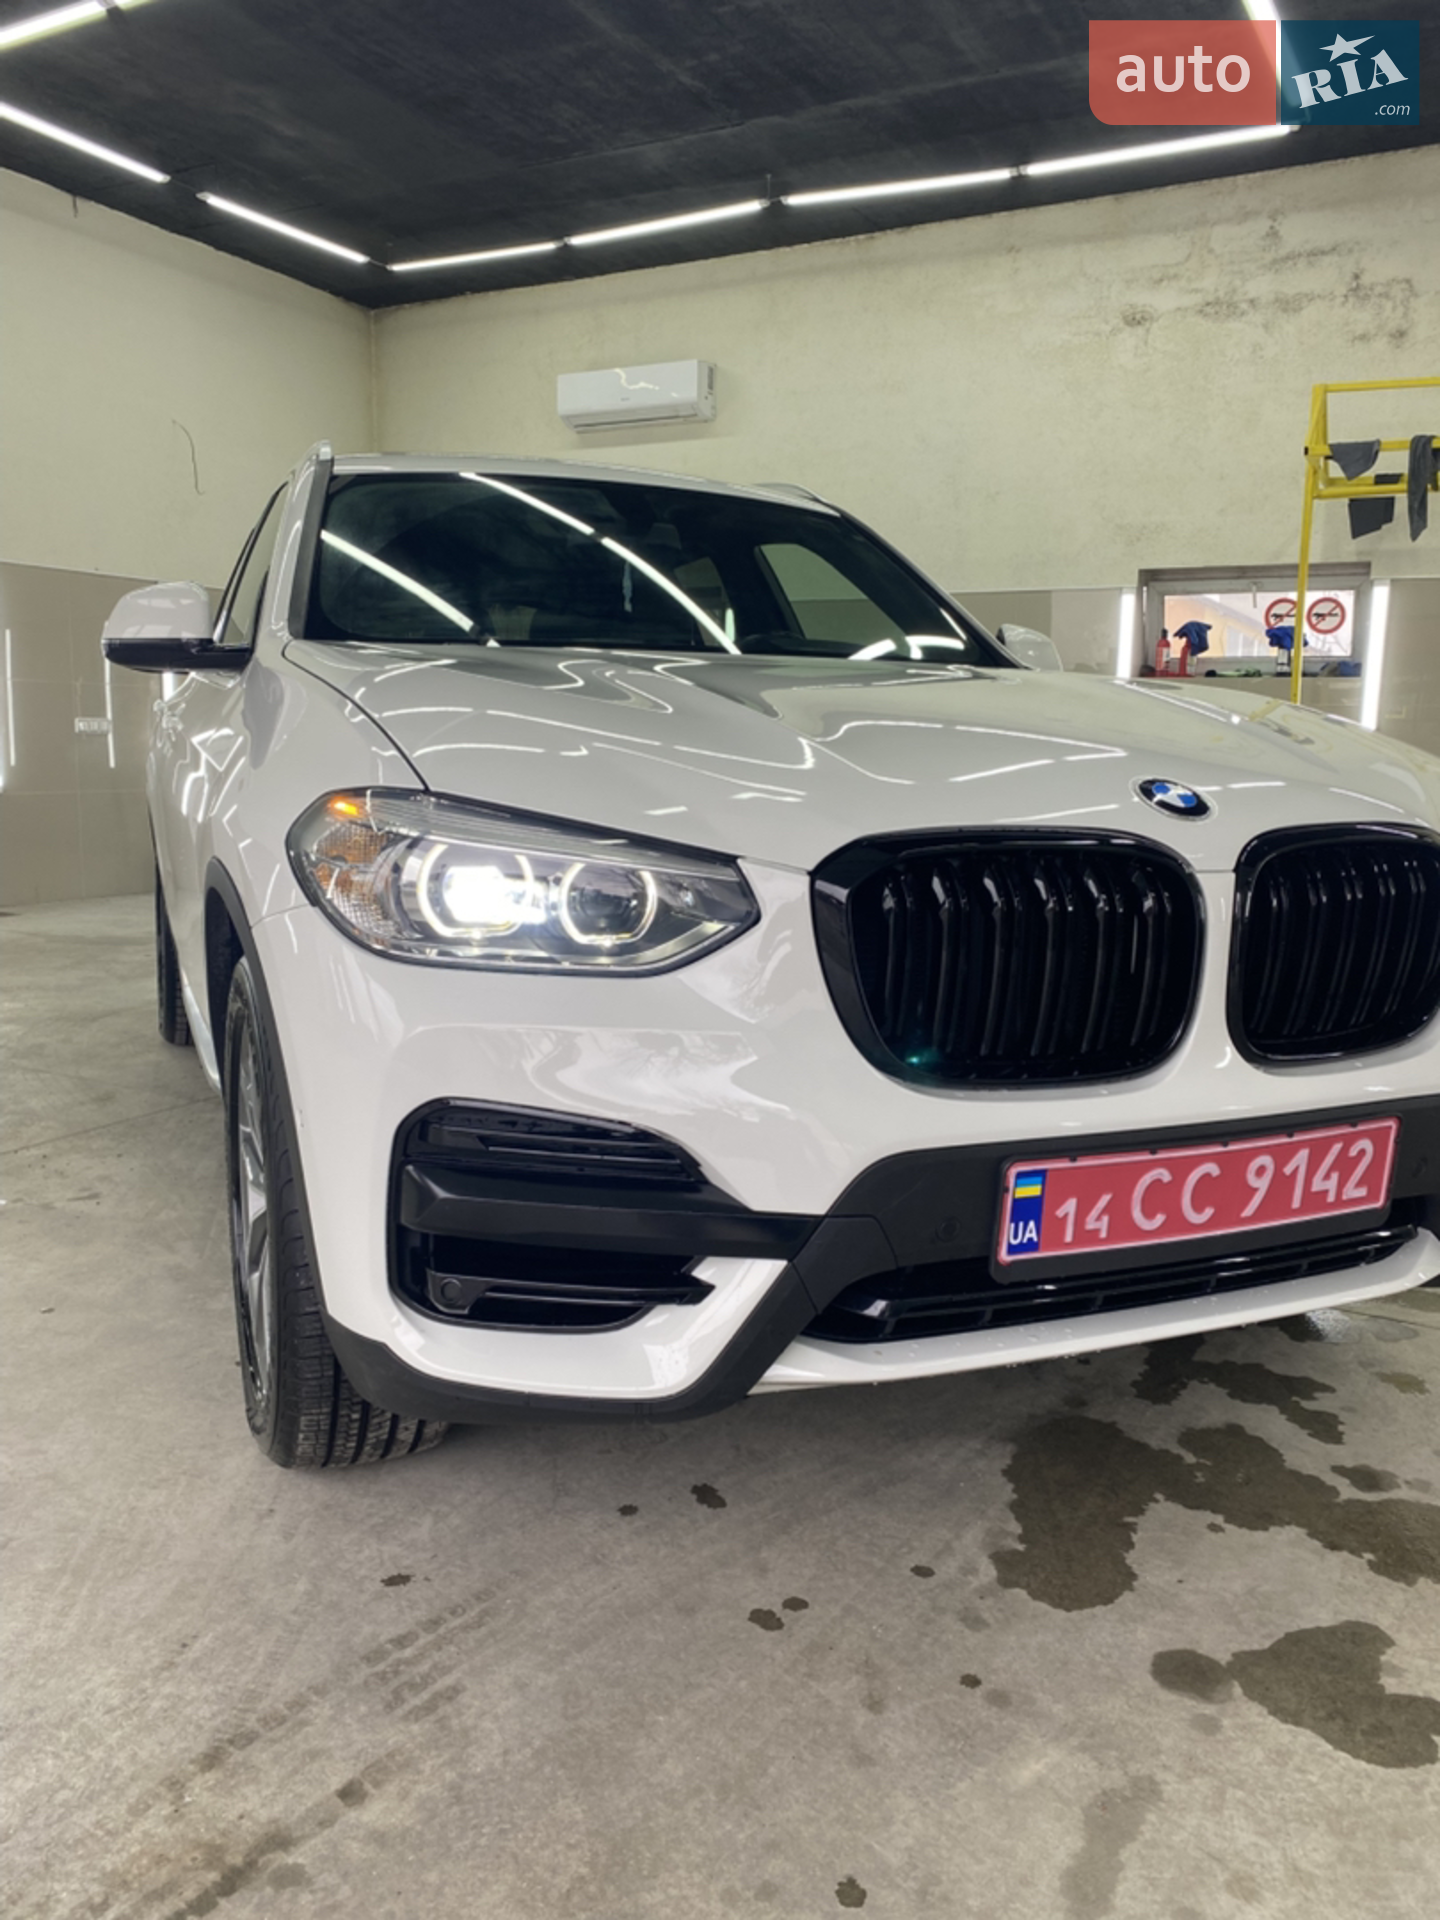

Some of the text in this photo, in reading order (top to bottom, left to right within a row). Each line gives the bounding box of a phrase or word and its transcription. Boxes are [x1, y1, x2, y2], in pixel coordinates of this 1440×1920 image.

[1055, 1138, 1374, 1243] 14 CC 9142
[1008, 1220, 1038, 1245] UA
